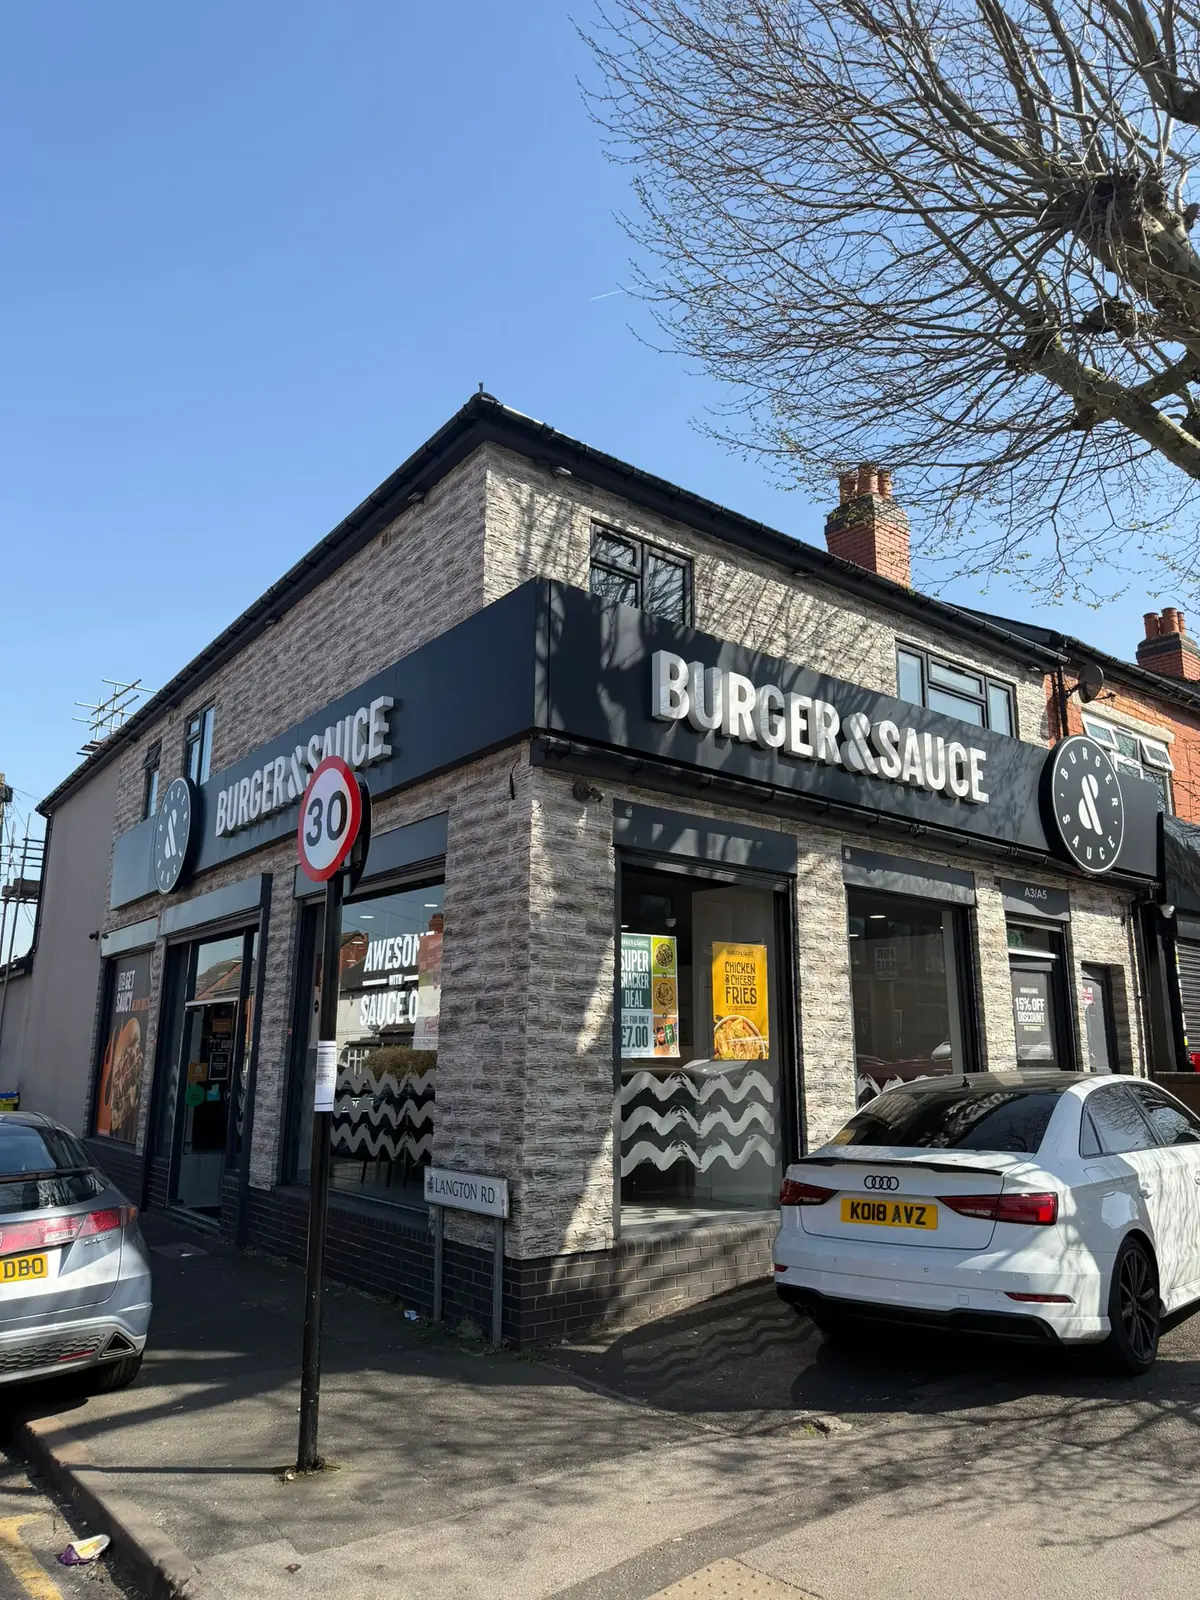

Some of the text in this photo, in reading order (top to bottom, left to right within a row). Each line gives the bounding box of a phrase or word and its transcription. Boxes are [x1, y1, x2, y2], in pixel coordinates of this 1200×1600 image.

[1060, 747, 1118, 807] BURGER
[305, 790, 347, 847] 30
[1062, 814, 1116, 860] SAUCE
[1024, 887, 1047, 900] A3/A5
[621, 949, 649, 972] SUPER
[725, 961, 756, 975] CHICKEN
[731, 974, 756, 987] CHEESE
[624, 989, 644, 1008] DEAL
[725, 986, 757, 1005] FRIES
[1014, 996, 1045, 1012] 15% OFF
[360, 990, 406, 1026] SAUCE
[1017, 1011, 1045, 1023] DISCOUNT
[621, 1025, 649, 1048] £7.00
[435, 1178, 478, 1200] LANGTON
[850, 1201, 926, 1226] KO18 AVZ
